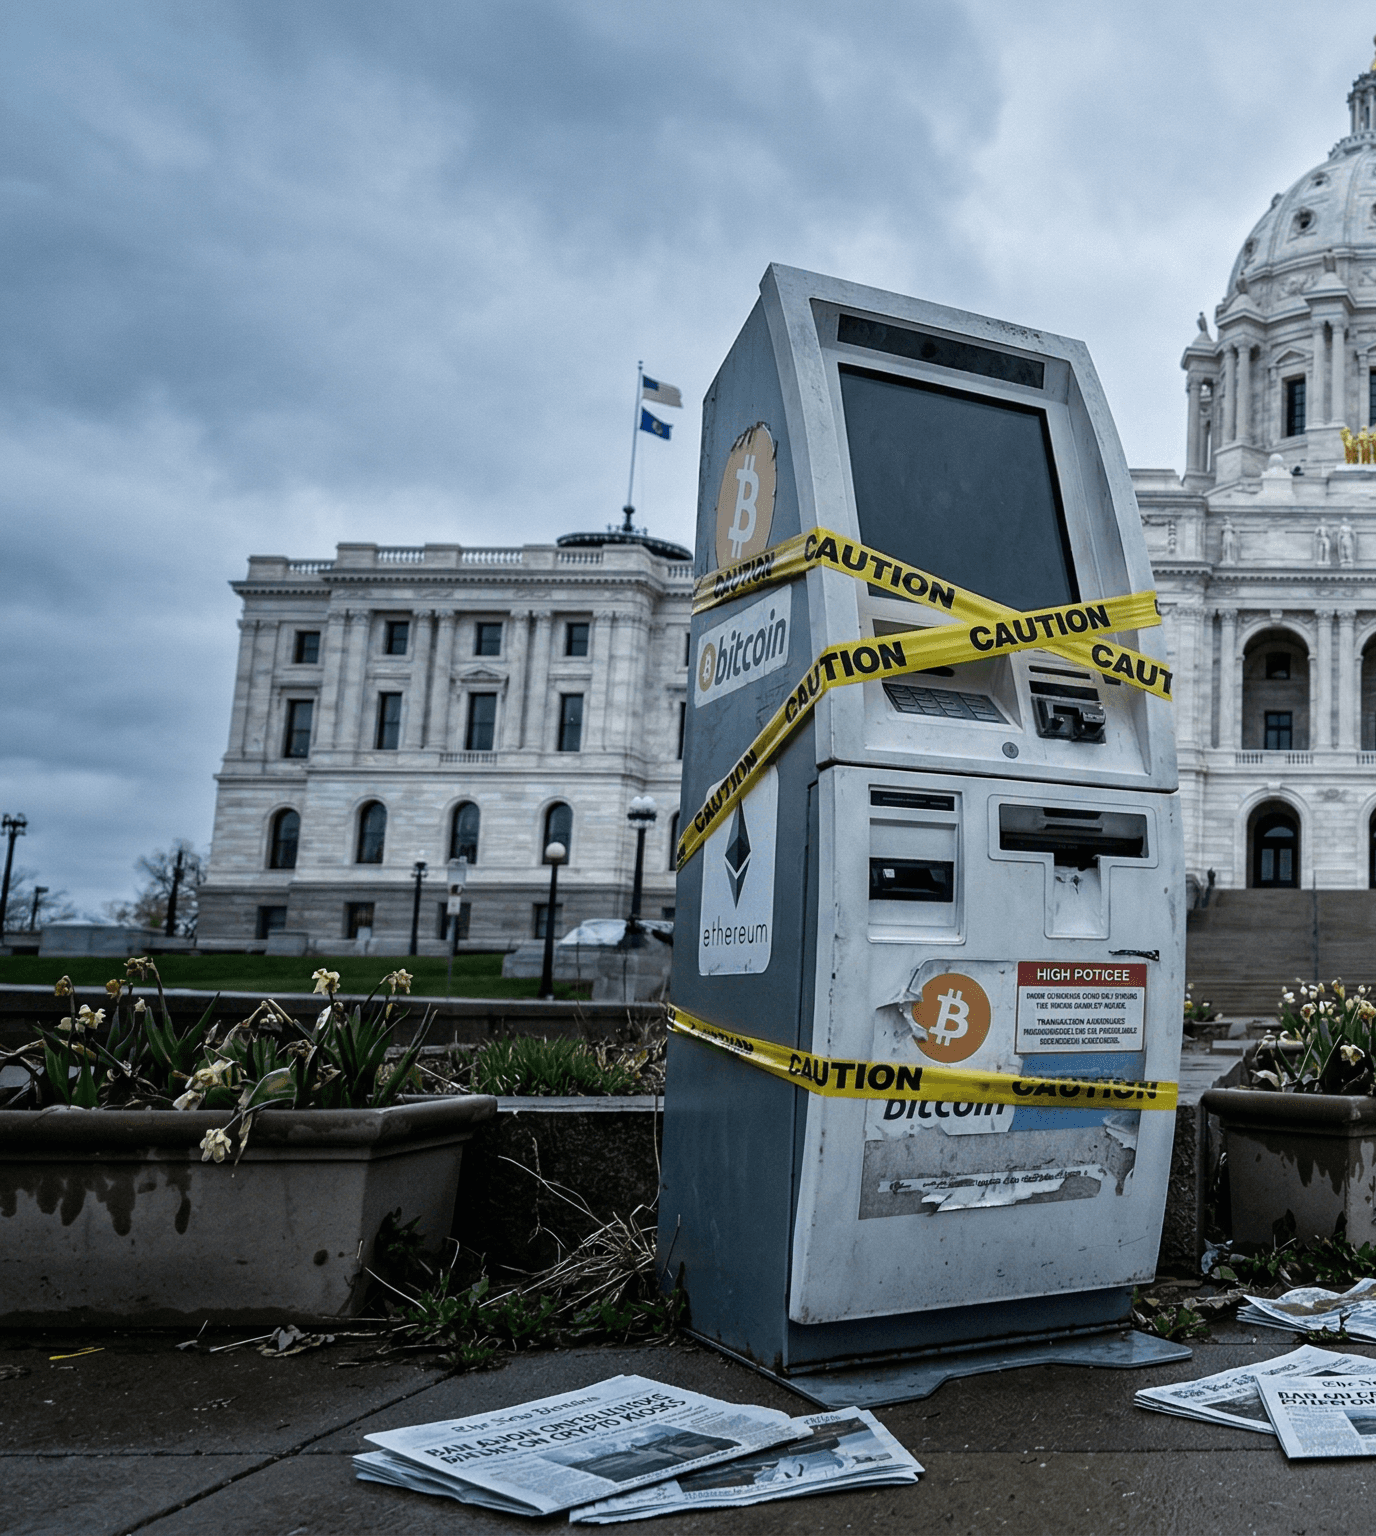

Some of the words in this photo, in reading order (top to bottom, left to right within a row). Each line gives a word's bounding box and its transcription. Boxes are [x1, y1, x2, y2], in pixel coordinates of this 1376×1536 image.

[713, 551, 775, 599] CAUTION
[804, 534, 956, 609] CAUTION
[714, 608, 787, 686] bitcoin
[969, 604, 1111, 651] CAUTION
[785, 641, 907, 724] CAUTION
[1091, 644, 1173, 695] CAUT
[694, 749, 758, 834] CAUTION
[703, 915, 768, 947] ethereum
[1036, 968, 1071, 981] HIGH
[1074, 969, 1130, 981] POTICEE
[788, 1053, 923, 1092] CAUTION
